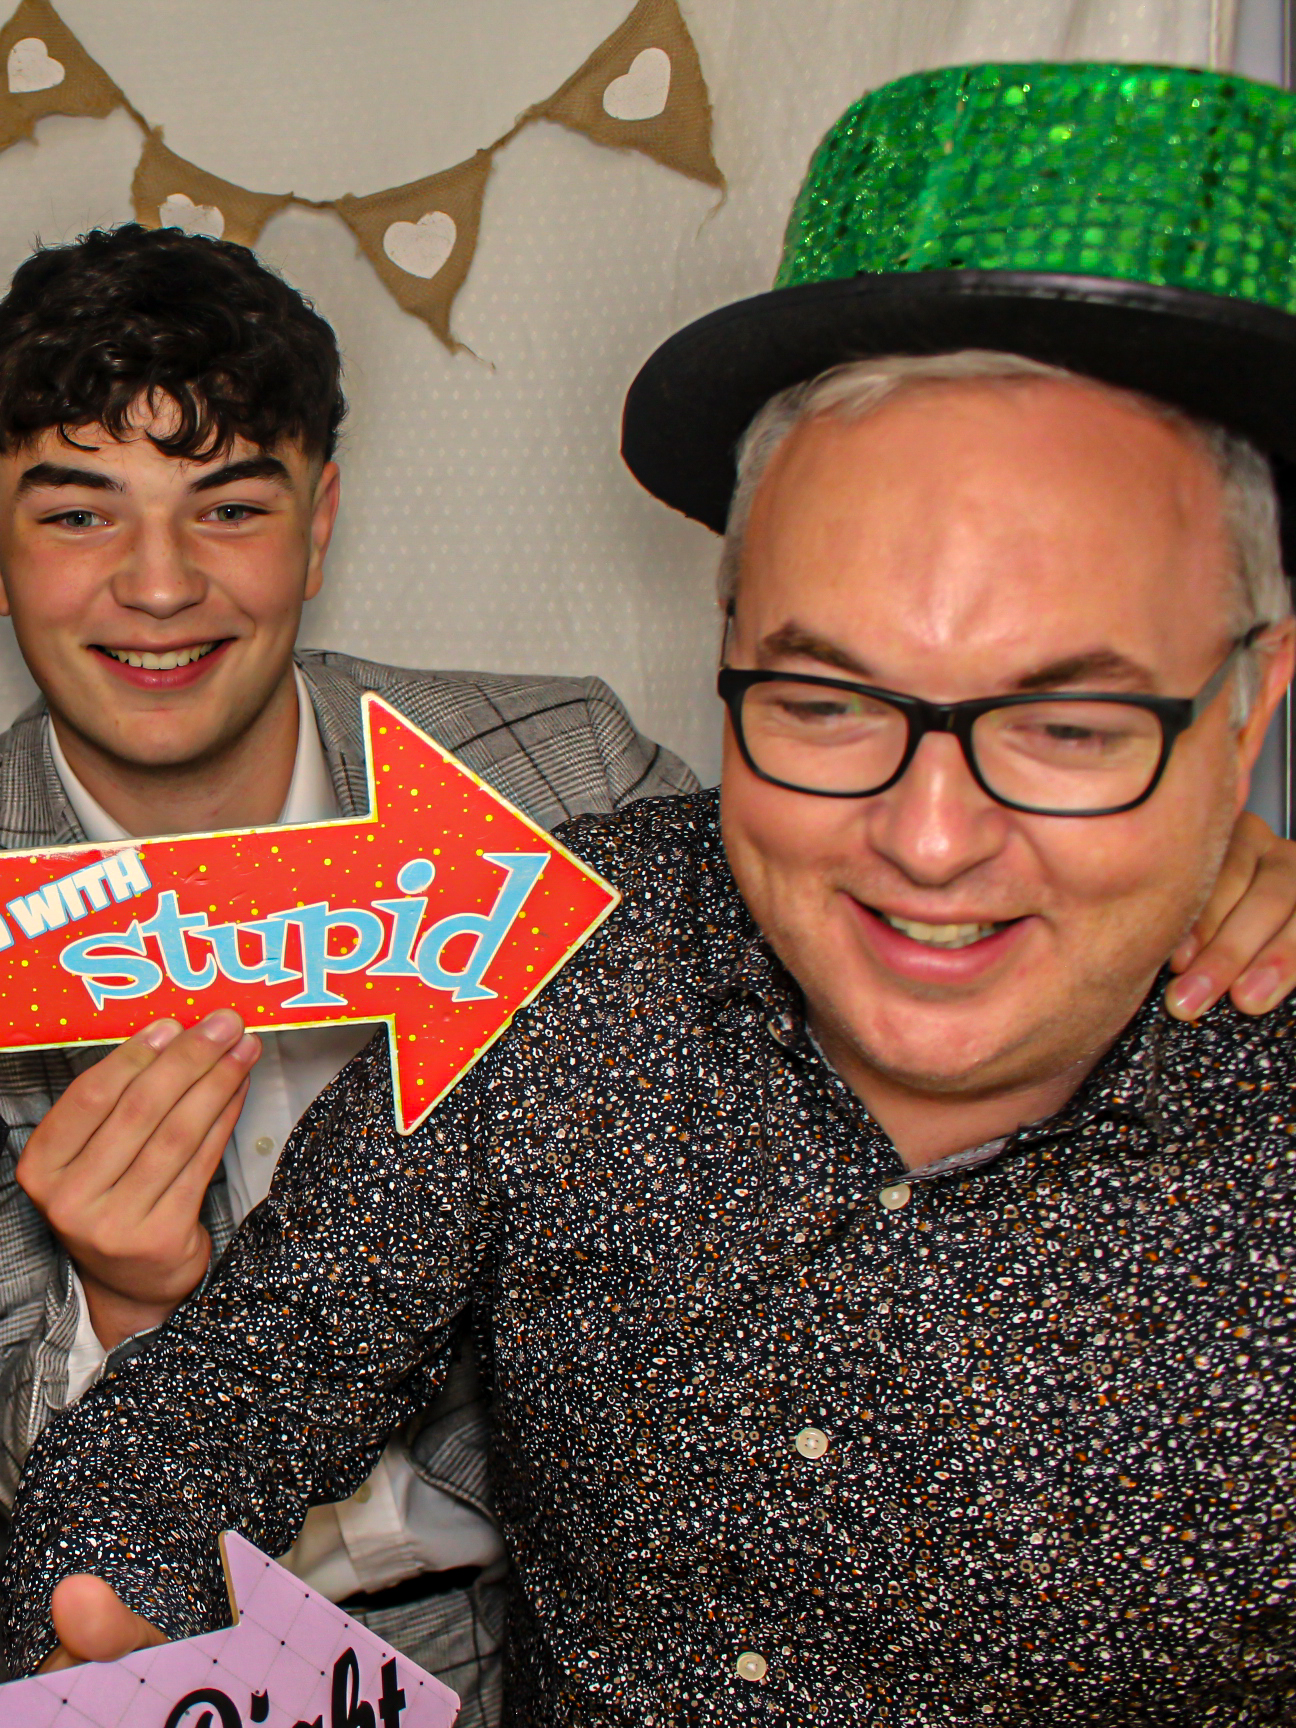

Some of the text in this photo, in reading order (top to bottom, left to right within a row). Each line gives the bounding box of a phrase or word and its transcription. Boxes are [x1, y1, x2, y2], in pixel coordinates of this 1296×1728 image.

[6, 849, 152, 939] WITH
[59, 852, 551, 1010] stupid
[164, 1646, 407, 1728] Rht
